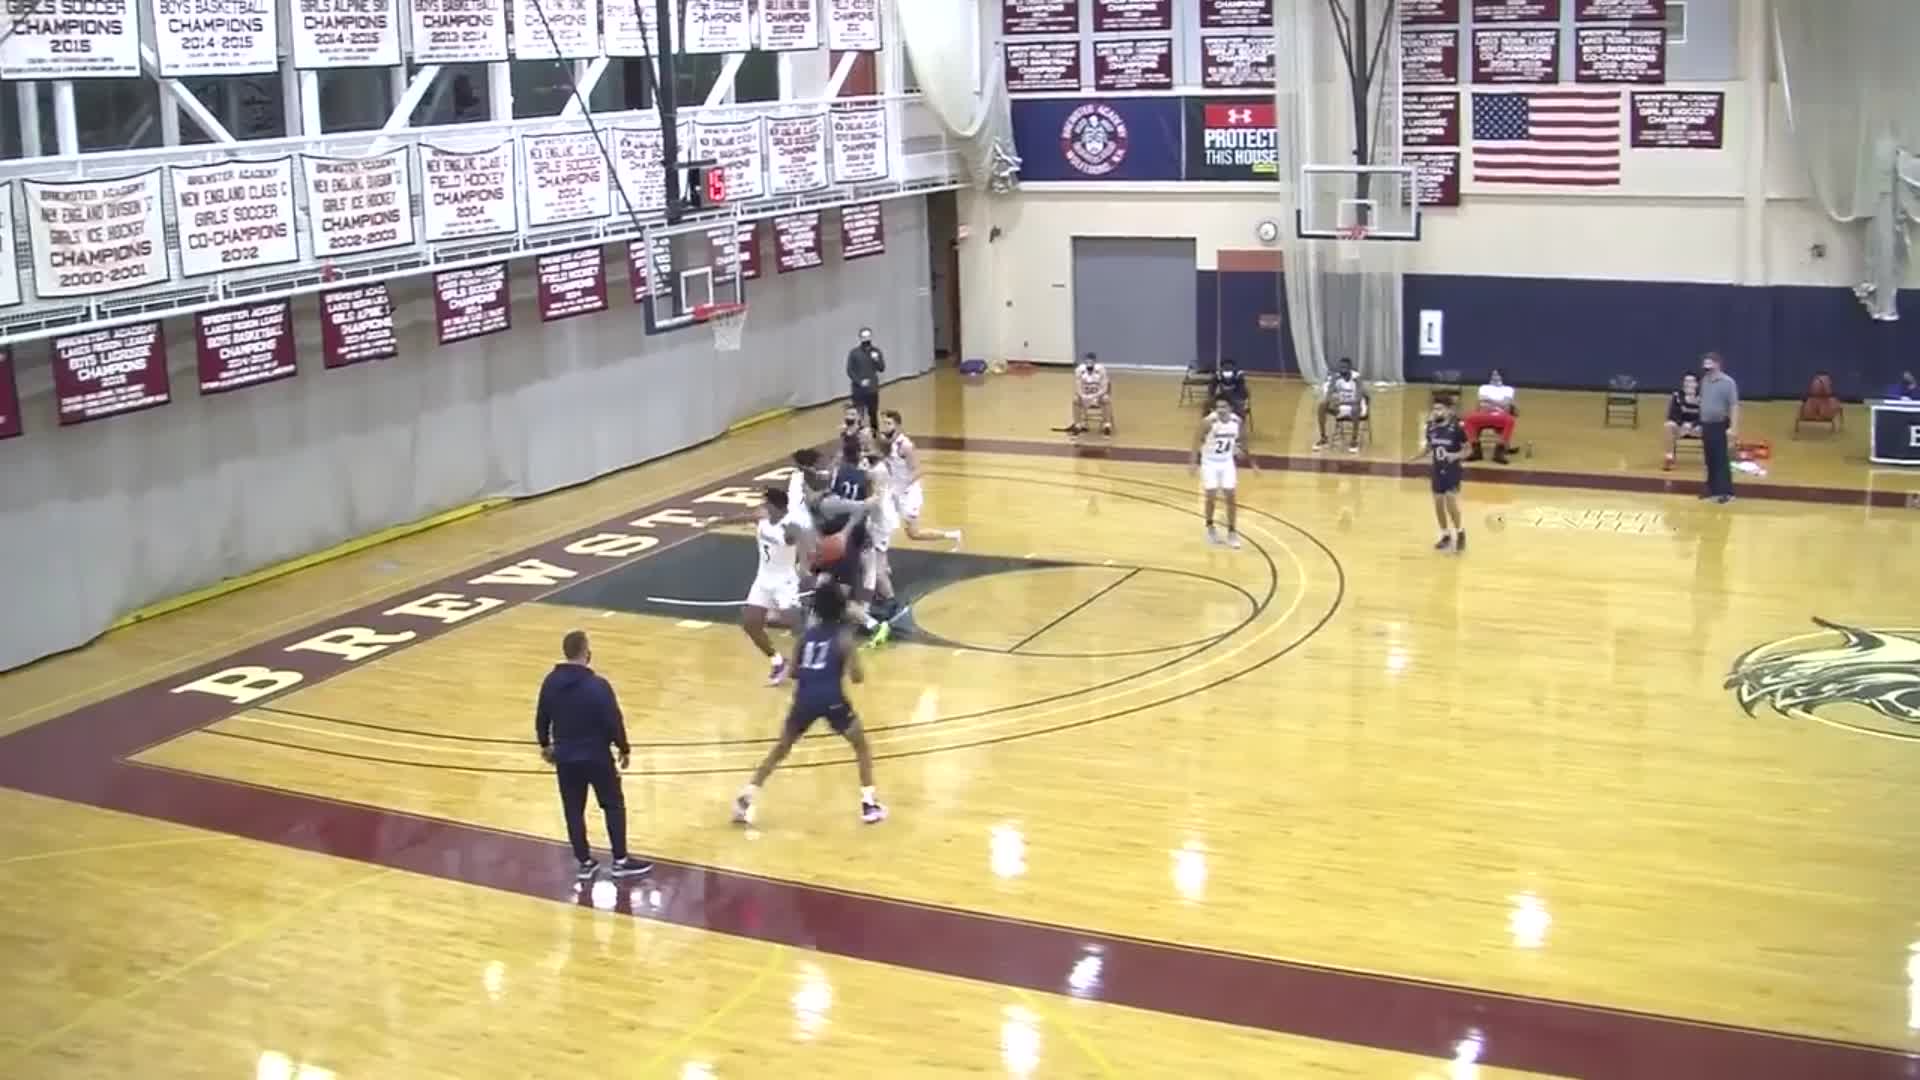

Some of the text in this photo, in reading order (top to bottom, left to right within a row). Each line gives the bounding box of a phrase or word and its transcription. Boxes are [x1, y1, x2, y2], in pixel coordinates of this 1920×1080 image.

[159, 0, 268, 14] BOYS BASKETBALL
[12, 20, 123, 35] CHAMPIONS
[168, 18, 263, 33] CHAMPIONS
[303, 15, 387, 29] CHAMPIONS
[422, 15, 494, 28] CHAMPIONS
[50, 40, 91, 52] 2015
[1640, 107, 1715, 116] GIRLS SOCCER
[1648, 116, 1706, 124] CHAMPIONS
[1204, 128, 1278, 148] PROTECT
[1205, 150, 1278, 165] THIS HOUSE
[464, 172, 504, 187] HOCKEY
[538, 170, 600, 188] CHAMPIONS
[433, 187, 504, 206] CHAMPIONS
[195, 204, 278, 227] GIRLS SOCCER
[456, 205, 484, 218] 2004
[322, 208, 400, 232] CHAMPIONS
[188, 222, 287, 249] CO-CHAMPIONS
[50, 240, 152, 267] CHAMPIONS
[60, 264, 147, 287] 2000-2001
[448, 292, 497, 310] CHAMPIONS
[219, 337, 277, 360] CHAMPIONS
[77, 358, 147, 381] CHAMPIONS
